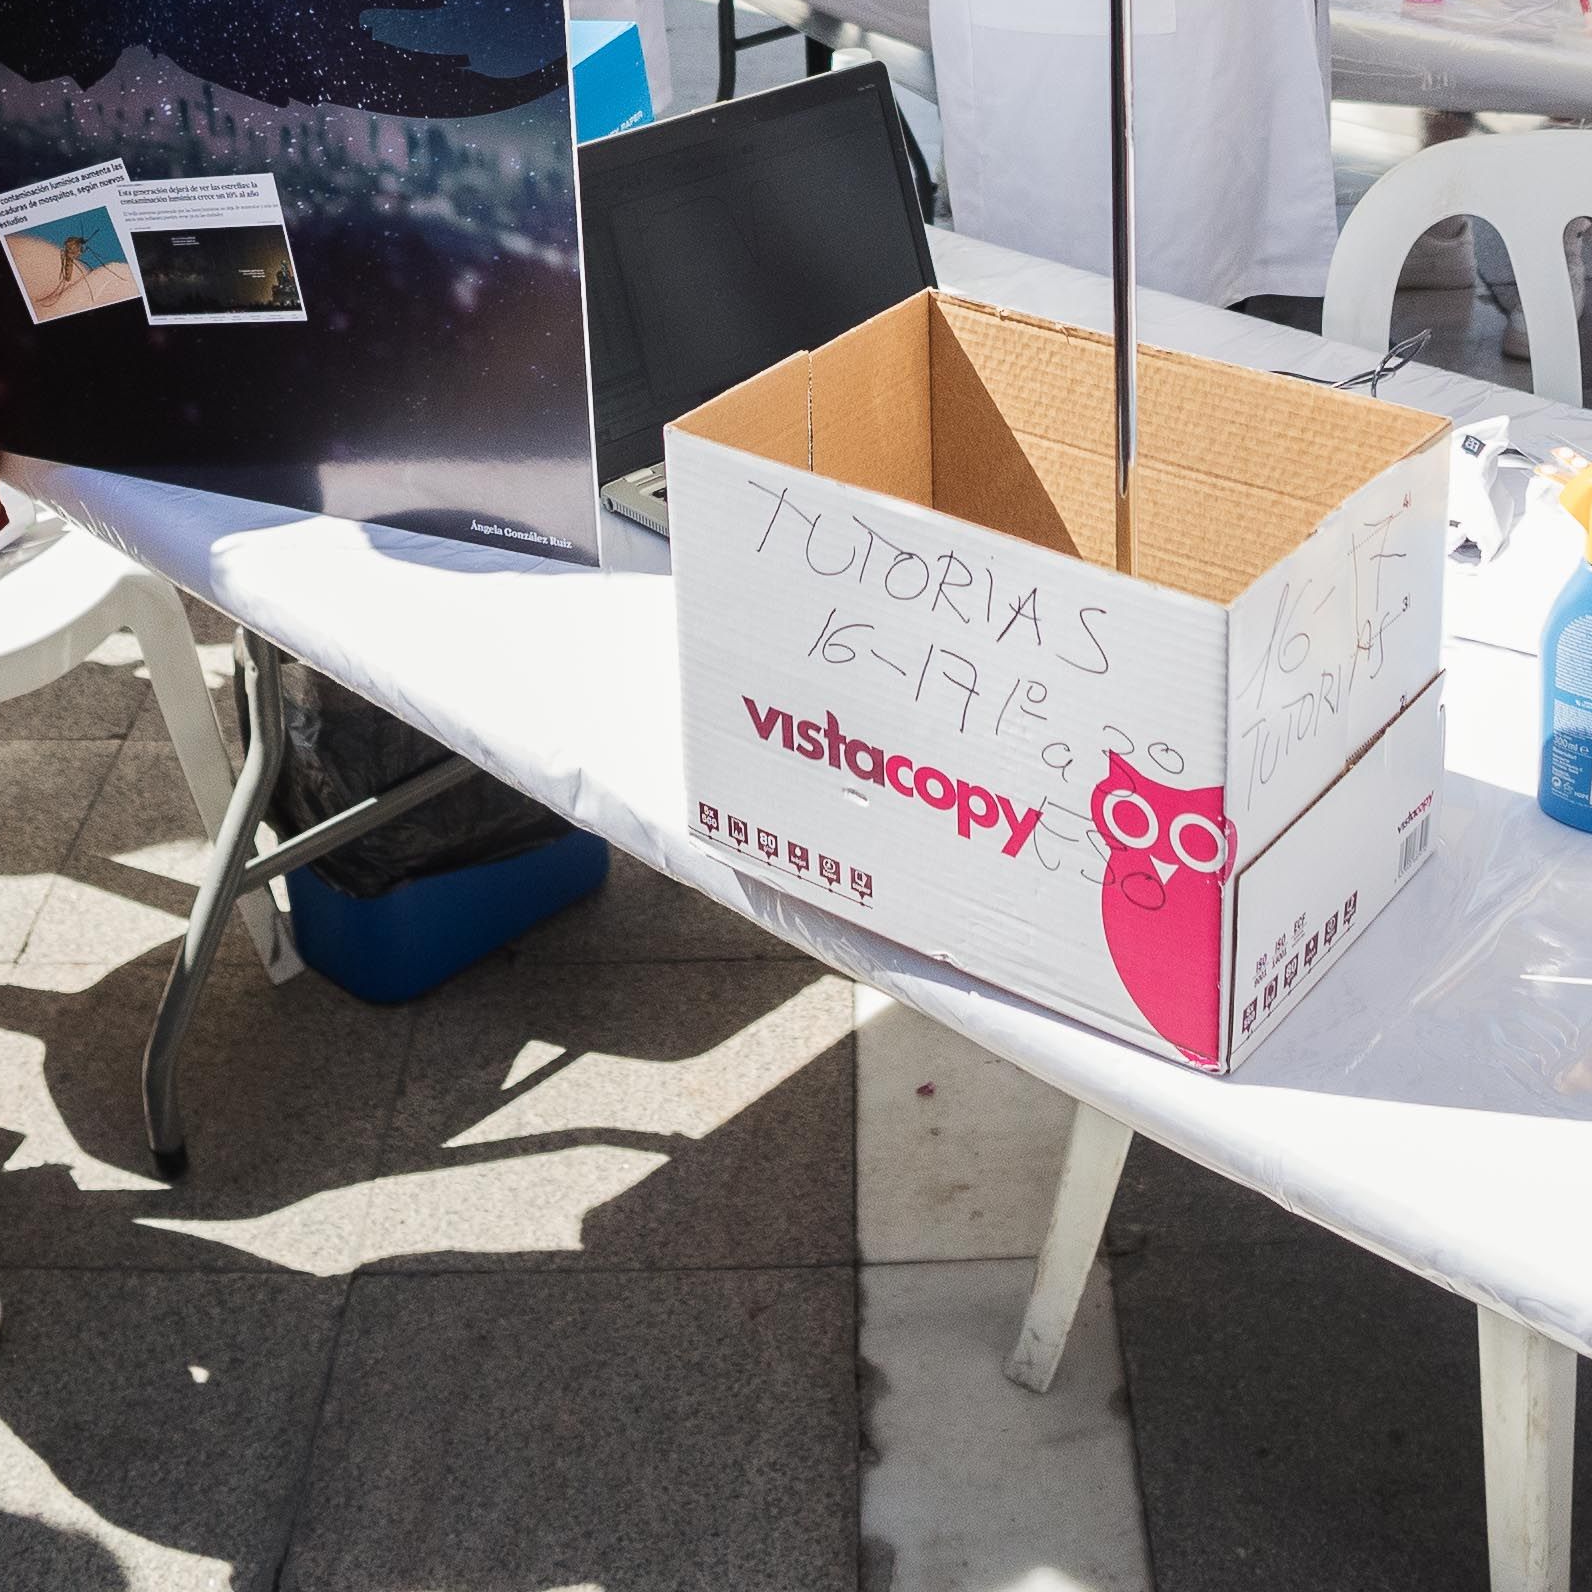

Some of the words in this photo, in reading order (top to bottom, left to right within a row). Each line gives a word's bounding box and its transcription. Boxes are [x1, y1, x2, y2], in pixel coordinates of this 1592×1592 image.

[0, 185, 50, 205] contaminación
[28, 199, 38, 208] de
[0, 216, 28, 229] estudios
[470, 519, 504, 535] Ángela
[504, 527, 548, 545] González
[549, 536, 573, 549] Ruiz
[748, 481, 1109, 675] TUTORIAS
[807, 608, 981, 733] 16-17
[1242, 612, 1391, 811] TUTORIAS
[741, 695, 1044, 858] vistacopy
[759, 832, 776, 849] 80
